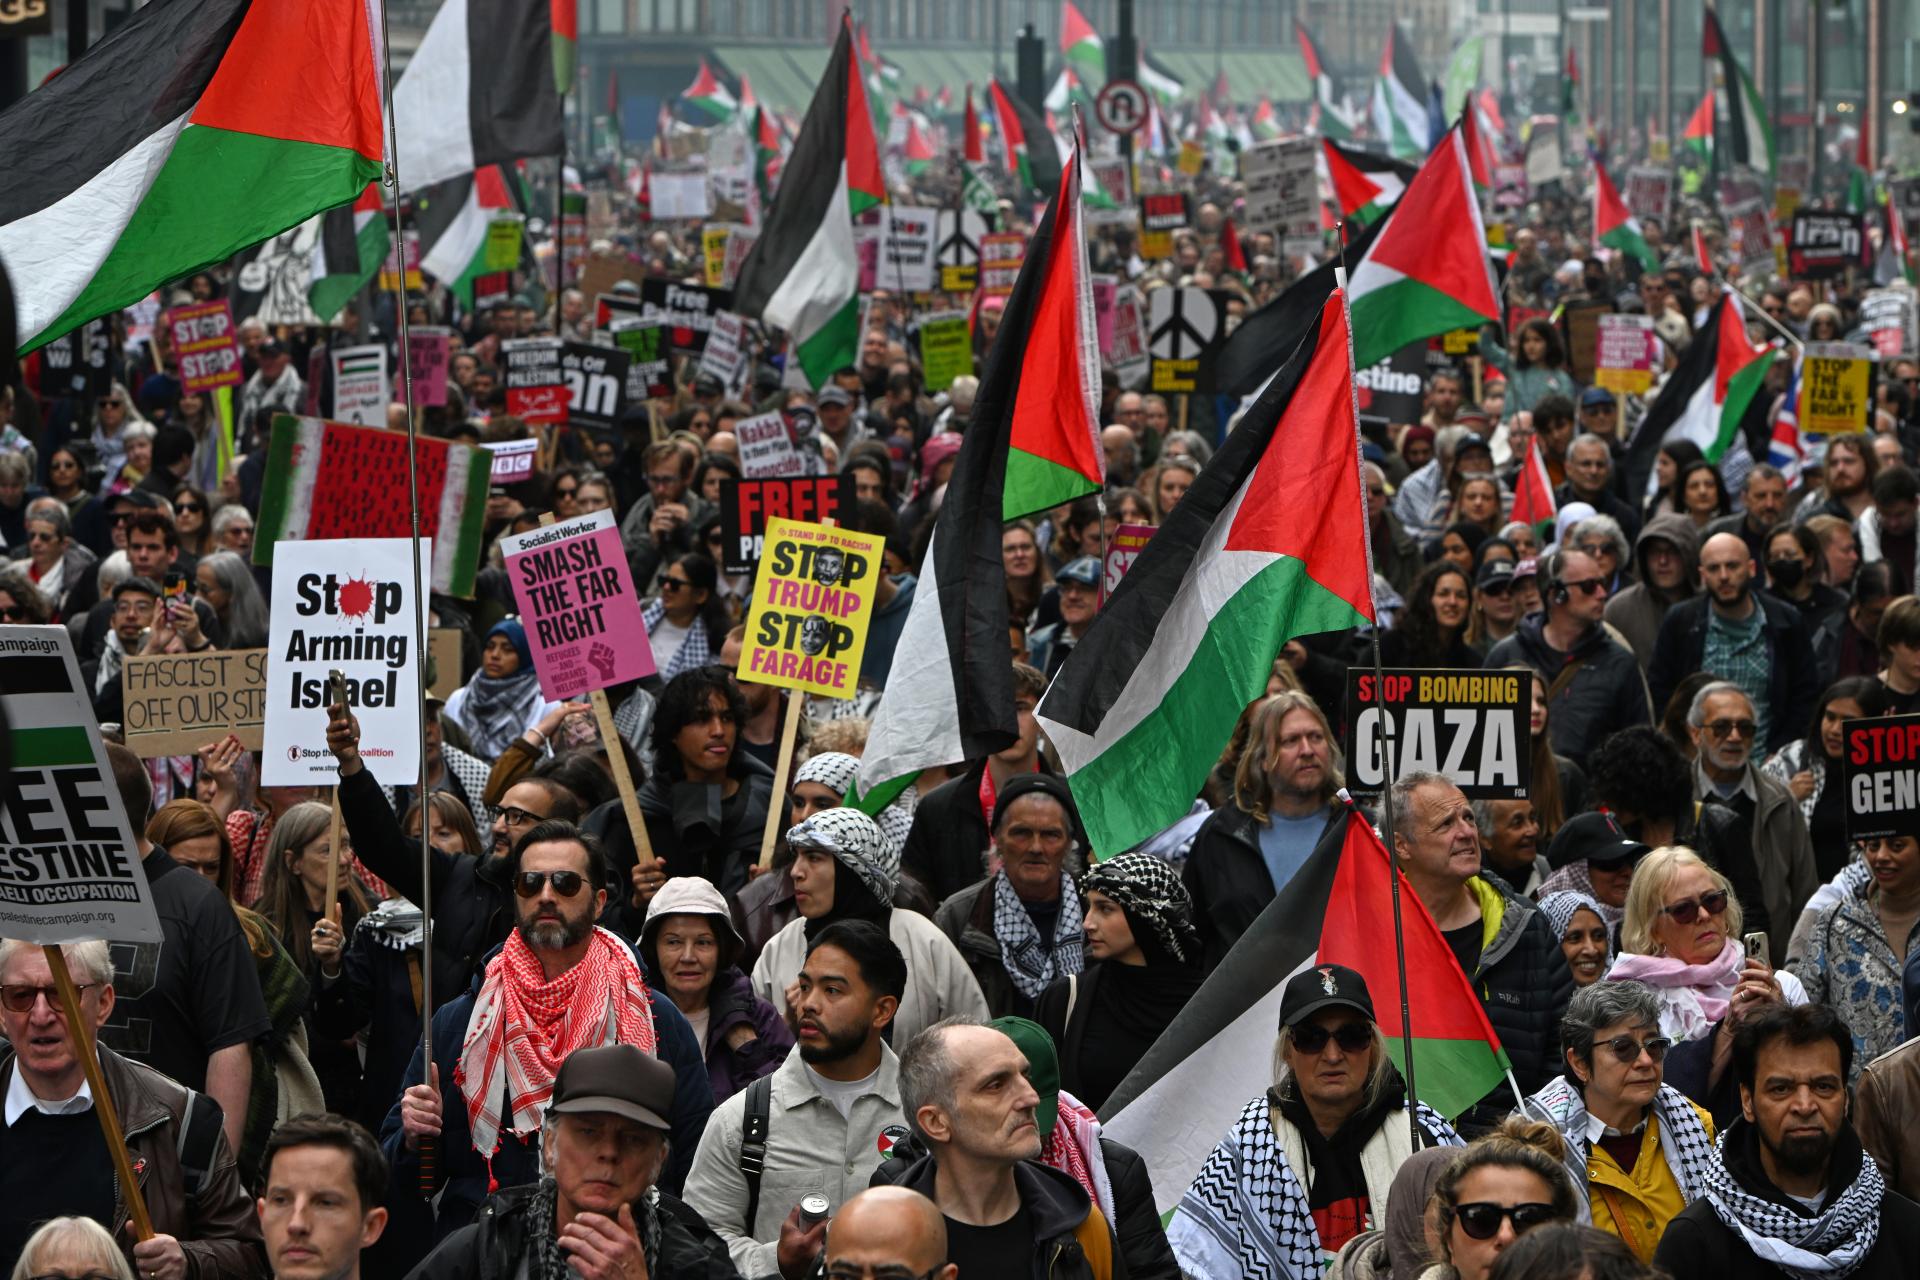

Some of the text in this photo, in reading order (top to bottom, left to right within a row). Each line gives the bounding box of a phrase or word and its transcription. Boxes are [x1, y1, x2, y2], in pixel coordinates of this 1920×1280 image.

[665, 284, 709, 310] Free
[1812, 359, 1853, 373] STOP
[1812, 374, 1840, 386] THE
[1810, 387, 1839, 400] FAR
[1810, 402, 1857, 417] RIGHT
[738, 417, 783, 445] Nakba
[519, 520, 598, 550] Socialist Worker
[788, 528, 873, 552] STAND UP TO RACISM
[519, 538, 602, 587] SMASH
[771, 540, 868, 588] STOP
[296, 573, 403, 625] Stop
[525, 566, 623, 618] THE FAR
[767, 577, 861, 619] TRUMP
[536, 603, 606, 650] RIGHT
[757, 610, 854, 660] STOP
[285, 628, 408, 669] Arming
[545, 646, 581, 664] REFUGEES
[127, 656, 233, 691] FASCIST
[550, 666, 588, 684] MIGRANTS
[750, 647, 849, 689] FARAGE
[290, 670, 398, 709] Israel
[554, 677, 588, 694] WELCOME
[1358, 675, 1519, 704] STOP BOMBING
[127, 697, 172, 730] OFF
[178, 691, 230, 724] OUR
[302, 748, 321, 759] Stop
[1355, 707, 1519, 786] GAZA
[1851, 769, 1920, 815] GEN
[32, 883, 138, 903] OCCUPATION
[1506, 993, 1520, 1005] Rab
